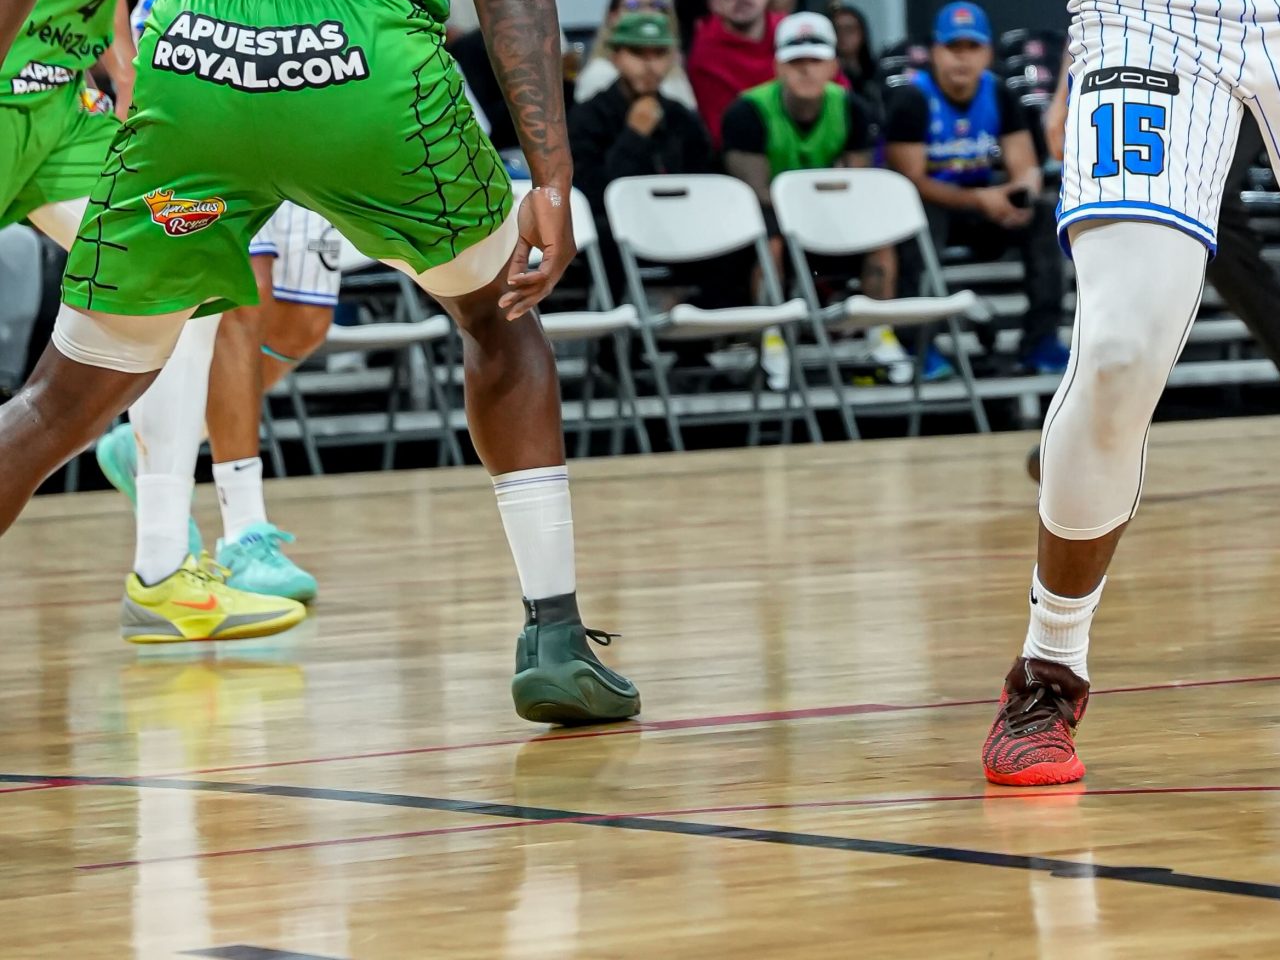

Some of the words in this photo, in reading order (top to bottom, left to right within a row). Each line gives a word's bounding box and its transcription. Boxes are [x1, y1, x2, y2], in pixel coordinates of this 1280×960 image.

[169, 14, 344, 56] APUESTAS
[154, 40, 366, 88] ROYAL.COM
[1091, 101, 1166, 178] 15
